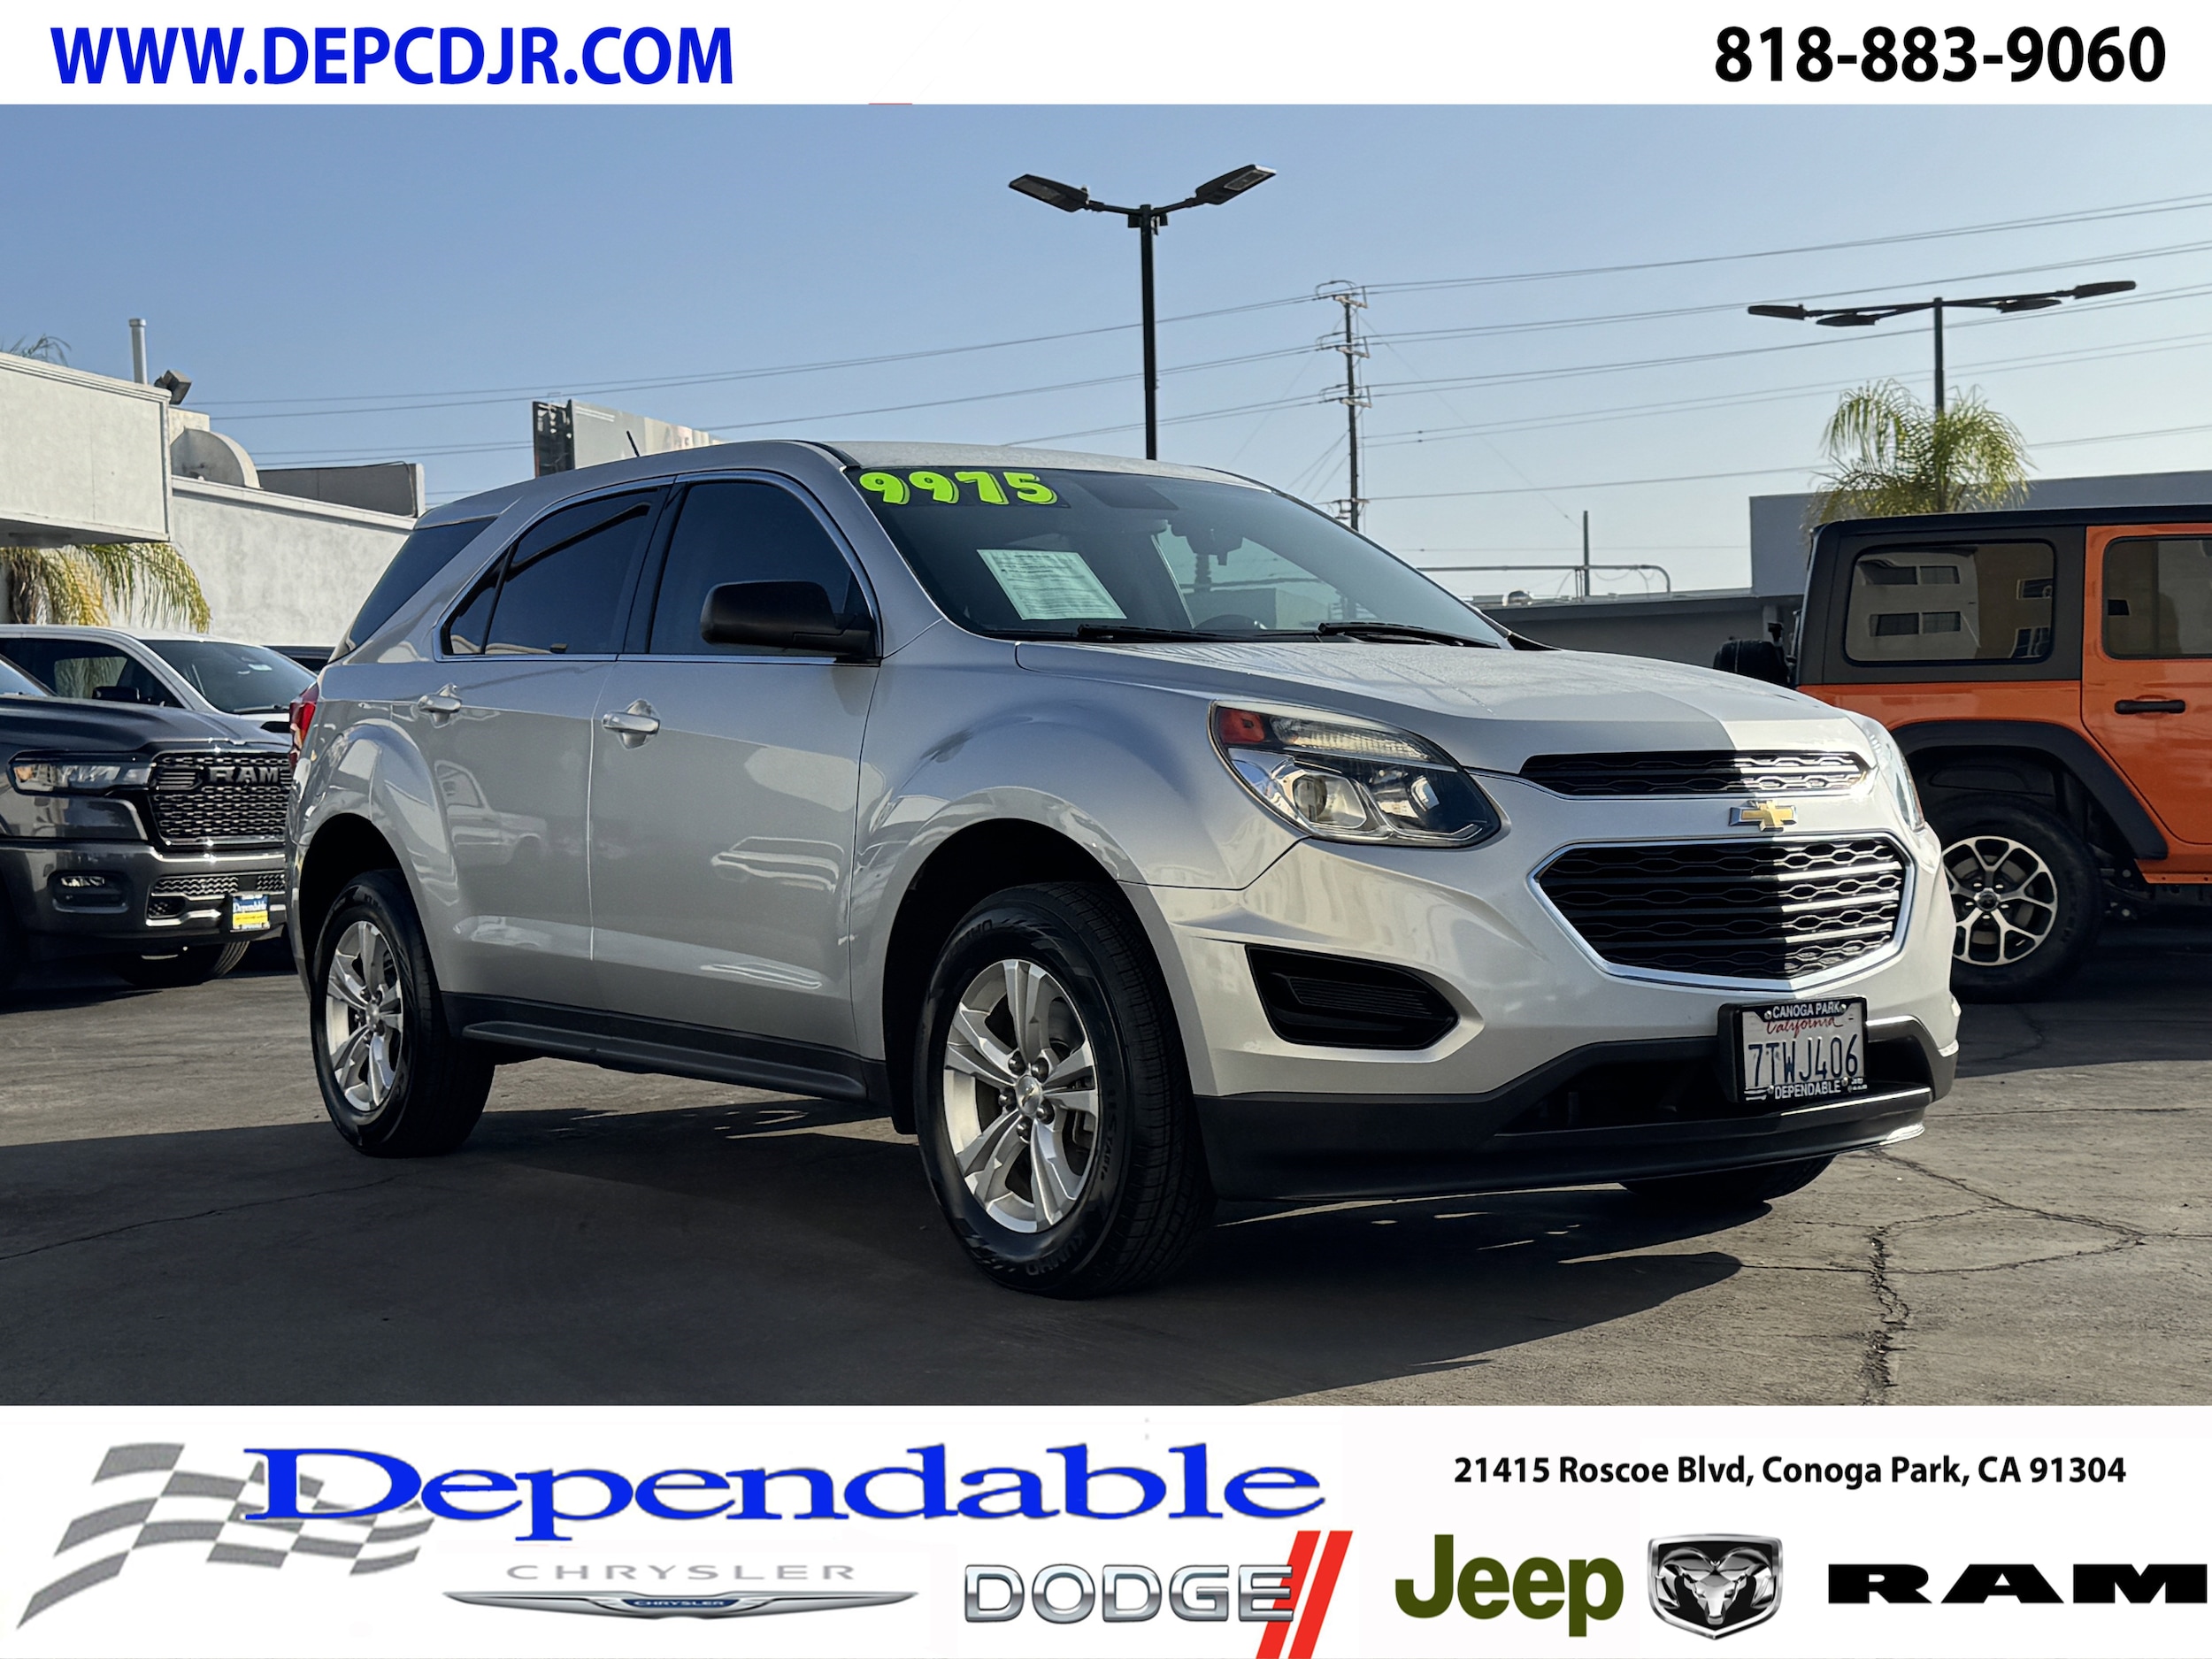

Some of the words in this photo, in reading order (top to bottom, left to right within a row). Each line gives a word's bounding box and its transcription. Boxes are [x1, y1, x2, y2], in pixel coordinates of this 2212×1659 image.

[859, 471, 1058, 505] 9975
[208, 765, 279, 783] RAM
[1772, 1003, 1813, 1019] CANOGA
[1816, 1001, 1840, 1016] PARK
[1766, 1017, 1844, 1038] California
[1748, 1033, 1858, 1087] 7TWJ406
[1774, 1079, 1842, 1100] DEPENDABLE
